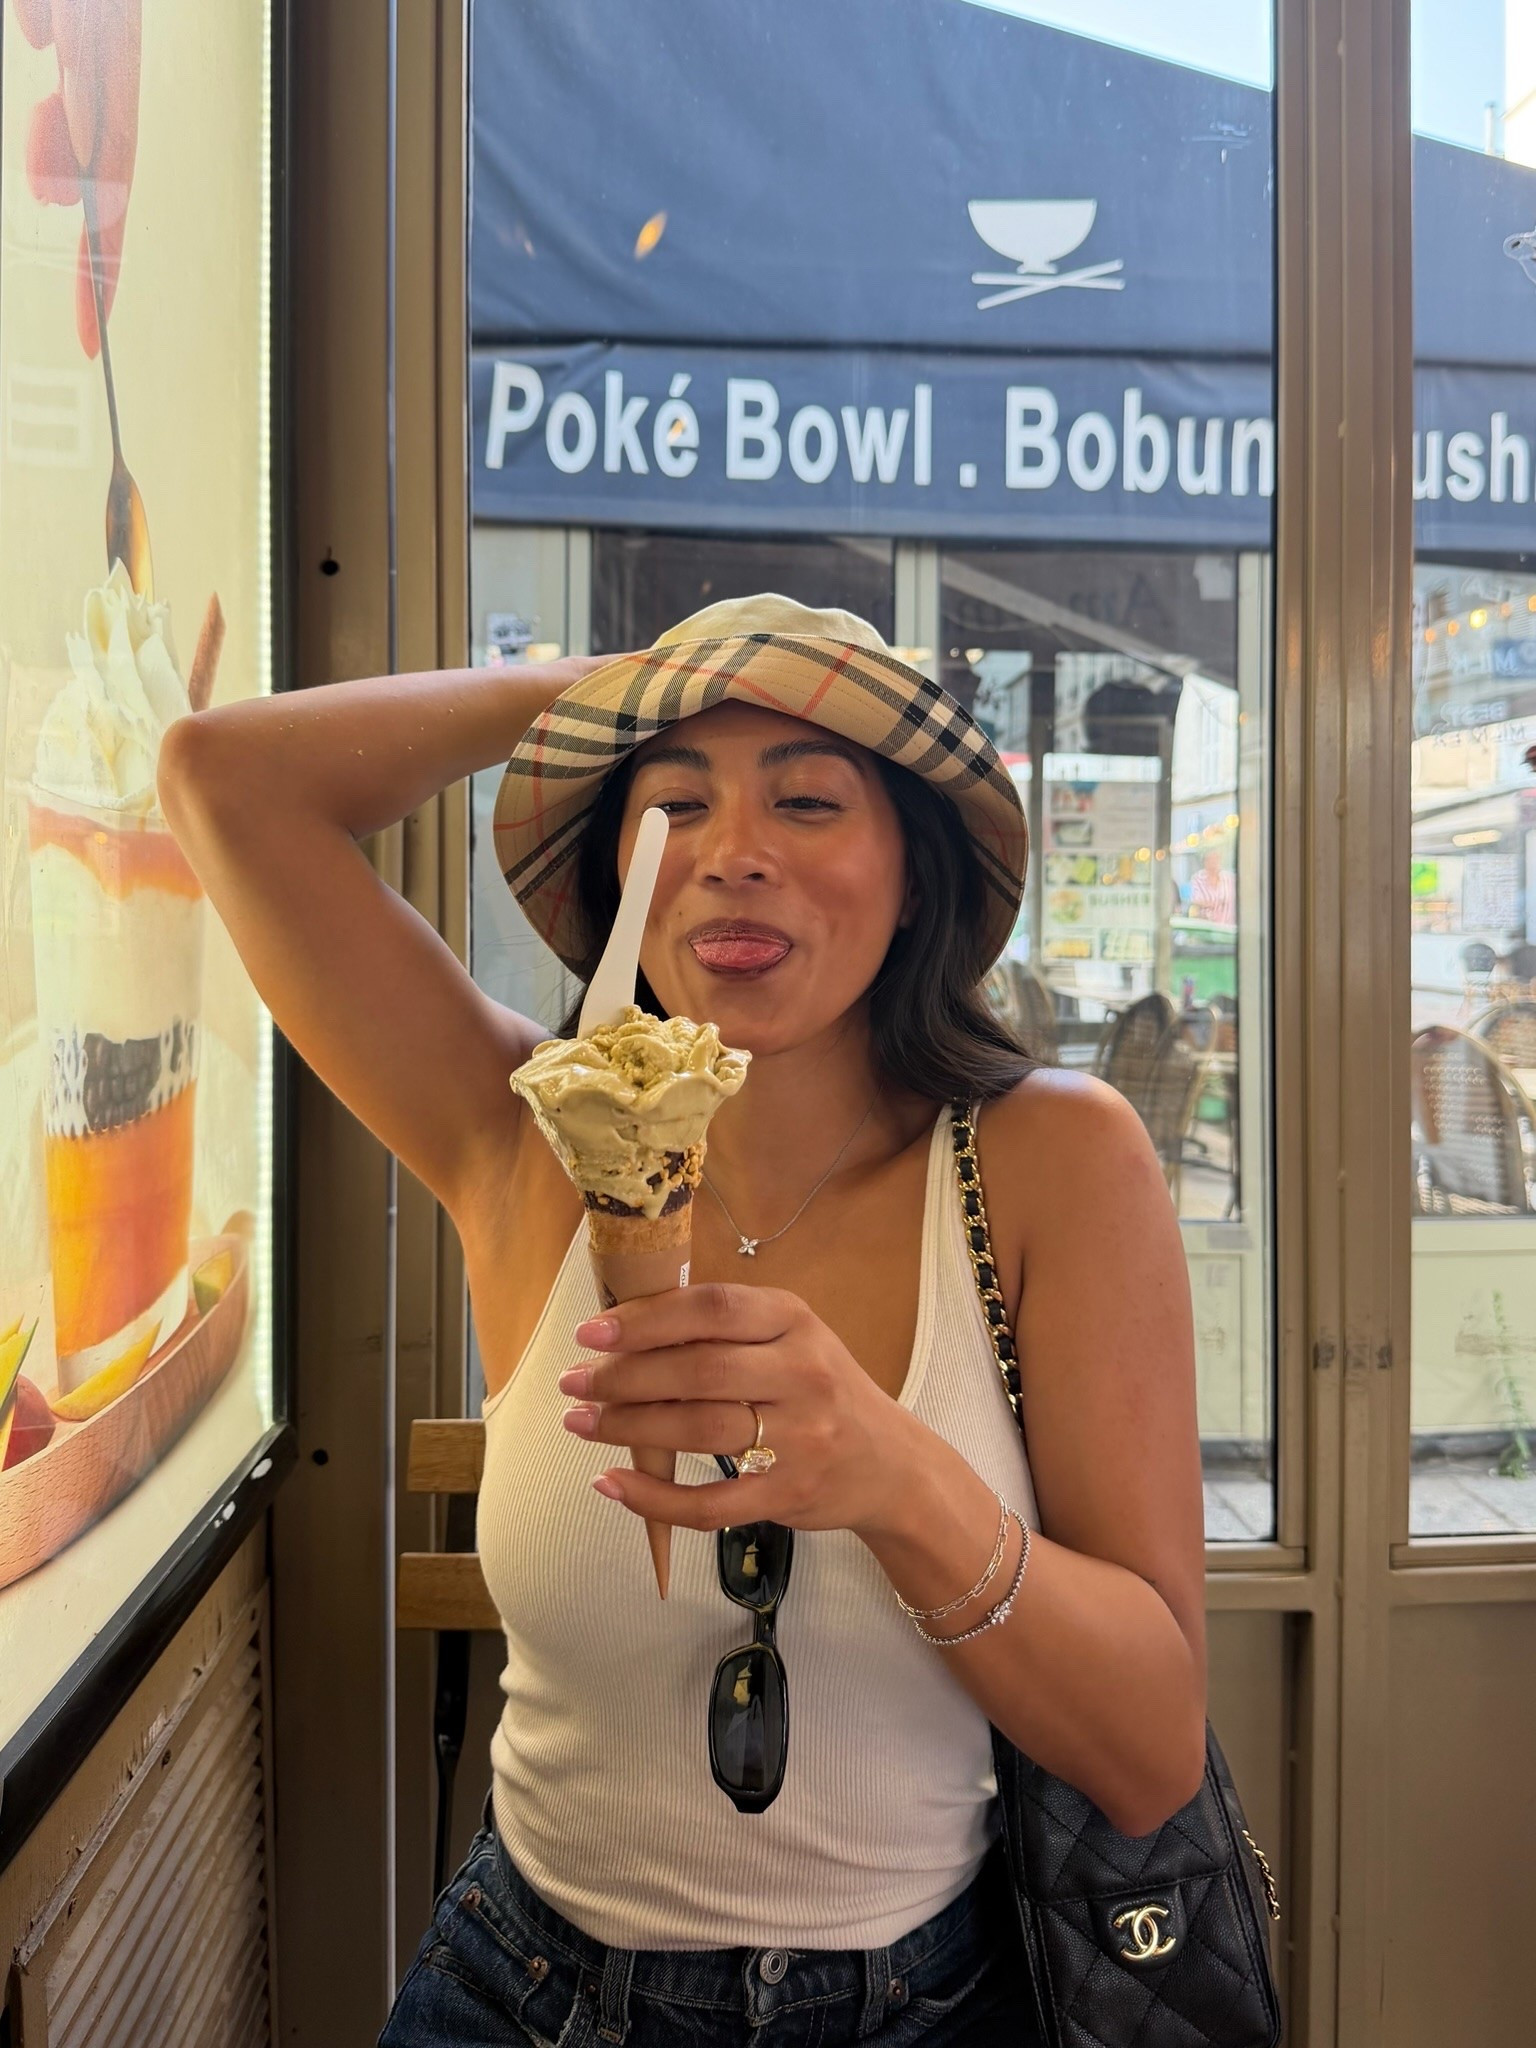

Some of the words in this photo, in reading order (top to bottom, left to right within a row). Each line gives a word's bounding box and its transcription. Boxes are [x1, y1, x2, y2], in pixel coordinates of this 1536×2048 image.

[485, 360, 699, 479] Poké
[725, 377, 933, 486] Bowl
[1005, 385, 1275, 497] Bobun
[1412, 411, 1536, 504] ush
